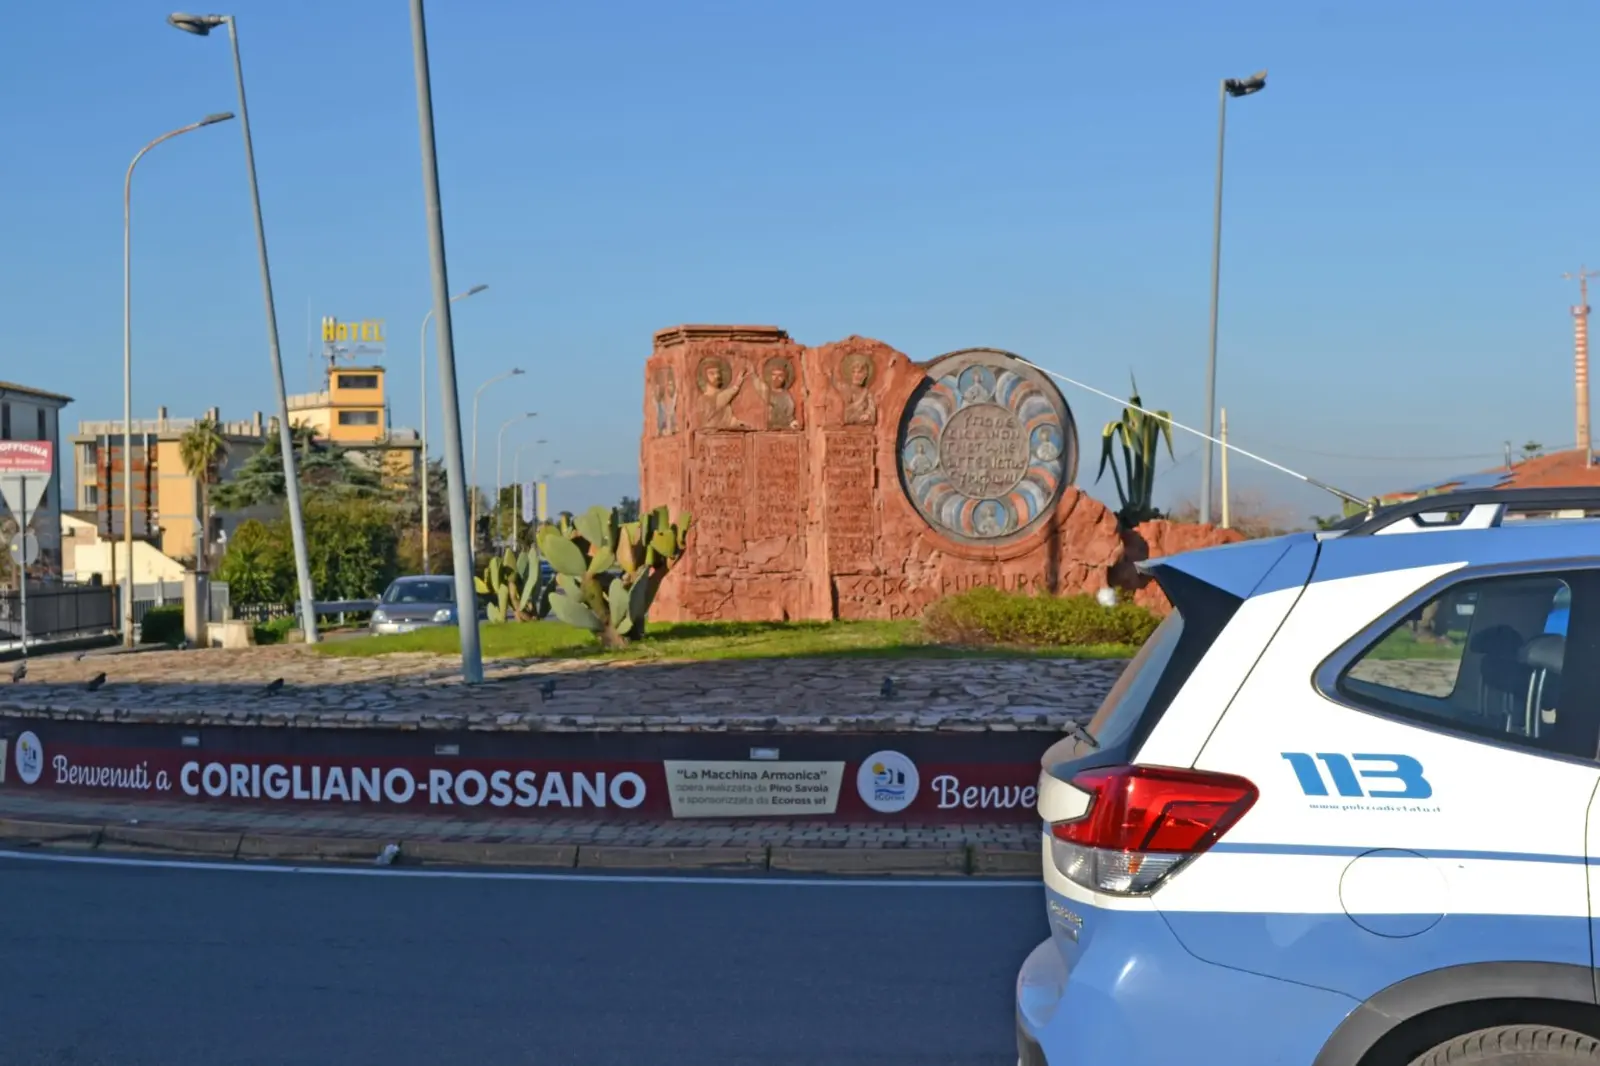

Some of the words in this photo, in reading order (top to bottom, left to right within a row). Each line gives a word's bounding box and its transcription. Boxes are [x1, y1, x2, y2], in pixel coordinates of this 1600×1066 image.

[322, 316, 384, 342] HOTEL
[52, 754, 151, 790] Benvenuti
[156, 768, 172, 790] a
[180, 761, 647, 809] CORIGLIANO-ROSSANO
[701, 769, 758, 780] Macchina
[1280, 752, 1433, 799] 113
[675, 783, 704, 795] opera
[706, 783, 752, 792] realizzata
[754, 783, 767, 792] da
[769, 784, 793, 793] Pino
[795, 784, 829, 793] Savoia
[687, 796, 754, 806] sponsorizzata
[756, 796, 769, 804] da
[772, 796, 812, 805] Ecoross
[814, 796, 827, 805] srl
[931, 775, 1038, 809] Benve
